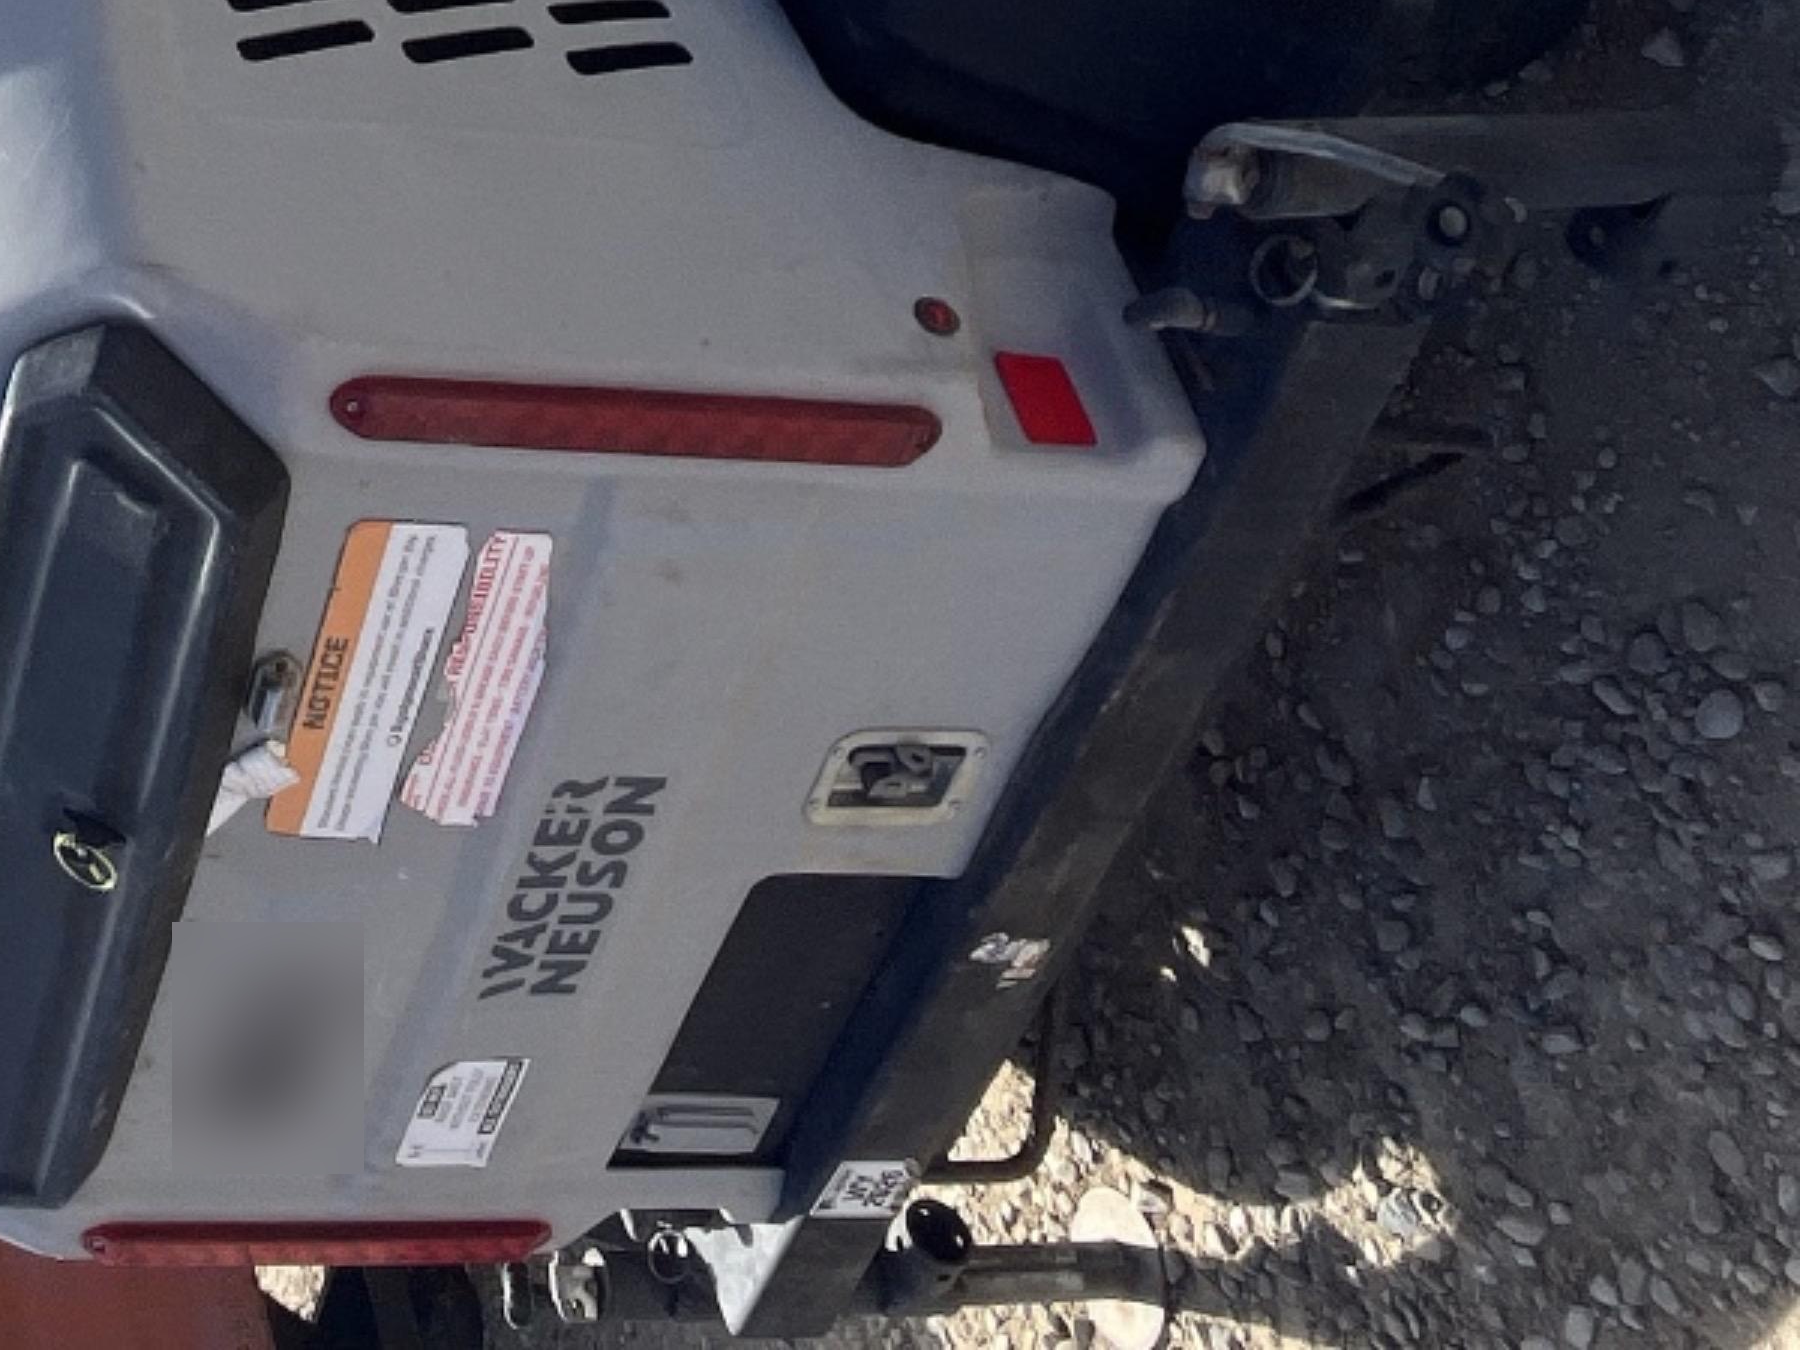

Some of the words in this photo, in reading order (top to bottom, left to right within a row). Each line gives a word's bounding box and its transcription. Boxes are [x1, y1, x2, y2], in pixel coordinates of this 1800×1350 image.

[303, 638, 351, 731] NOTICE
[477, 776, 610, 1000] WACKER
[528, 776, 668, 996] NEUSON
